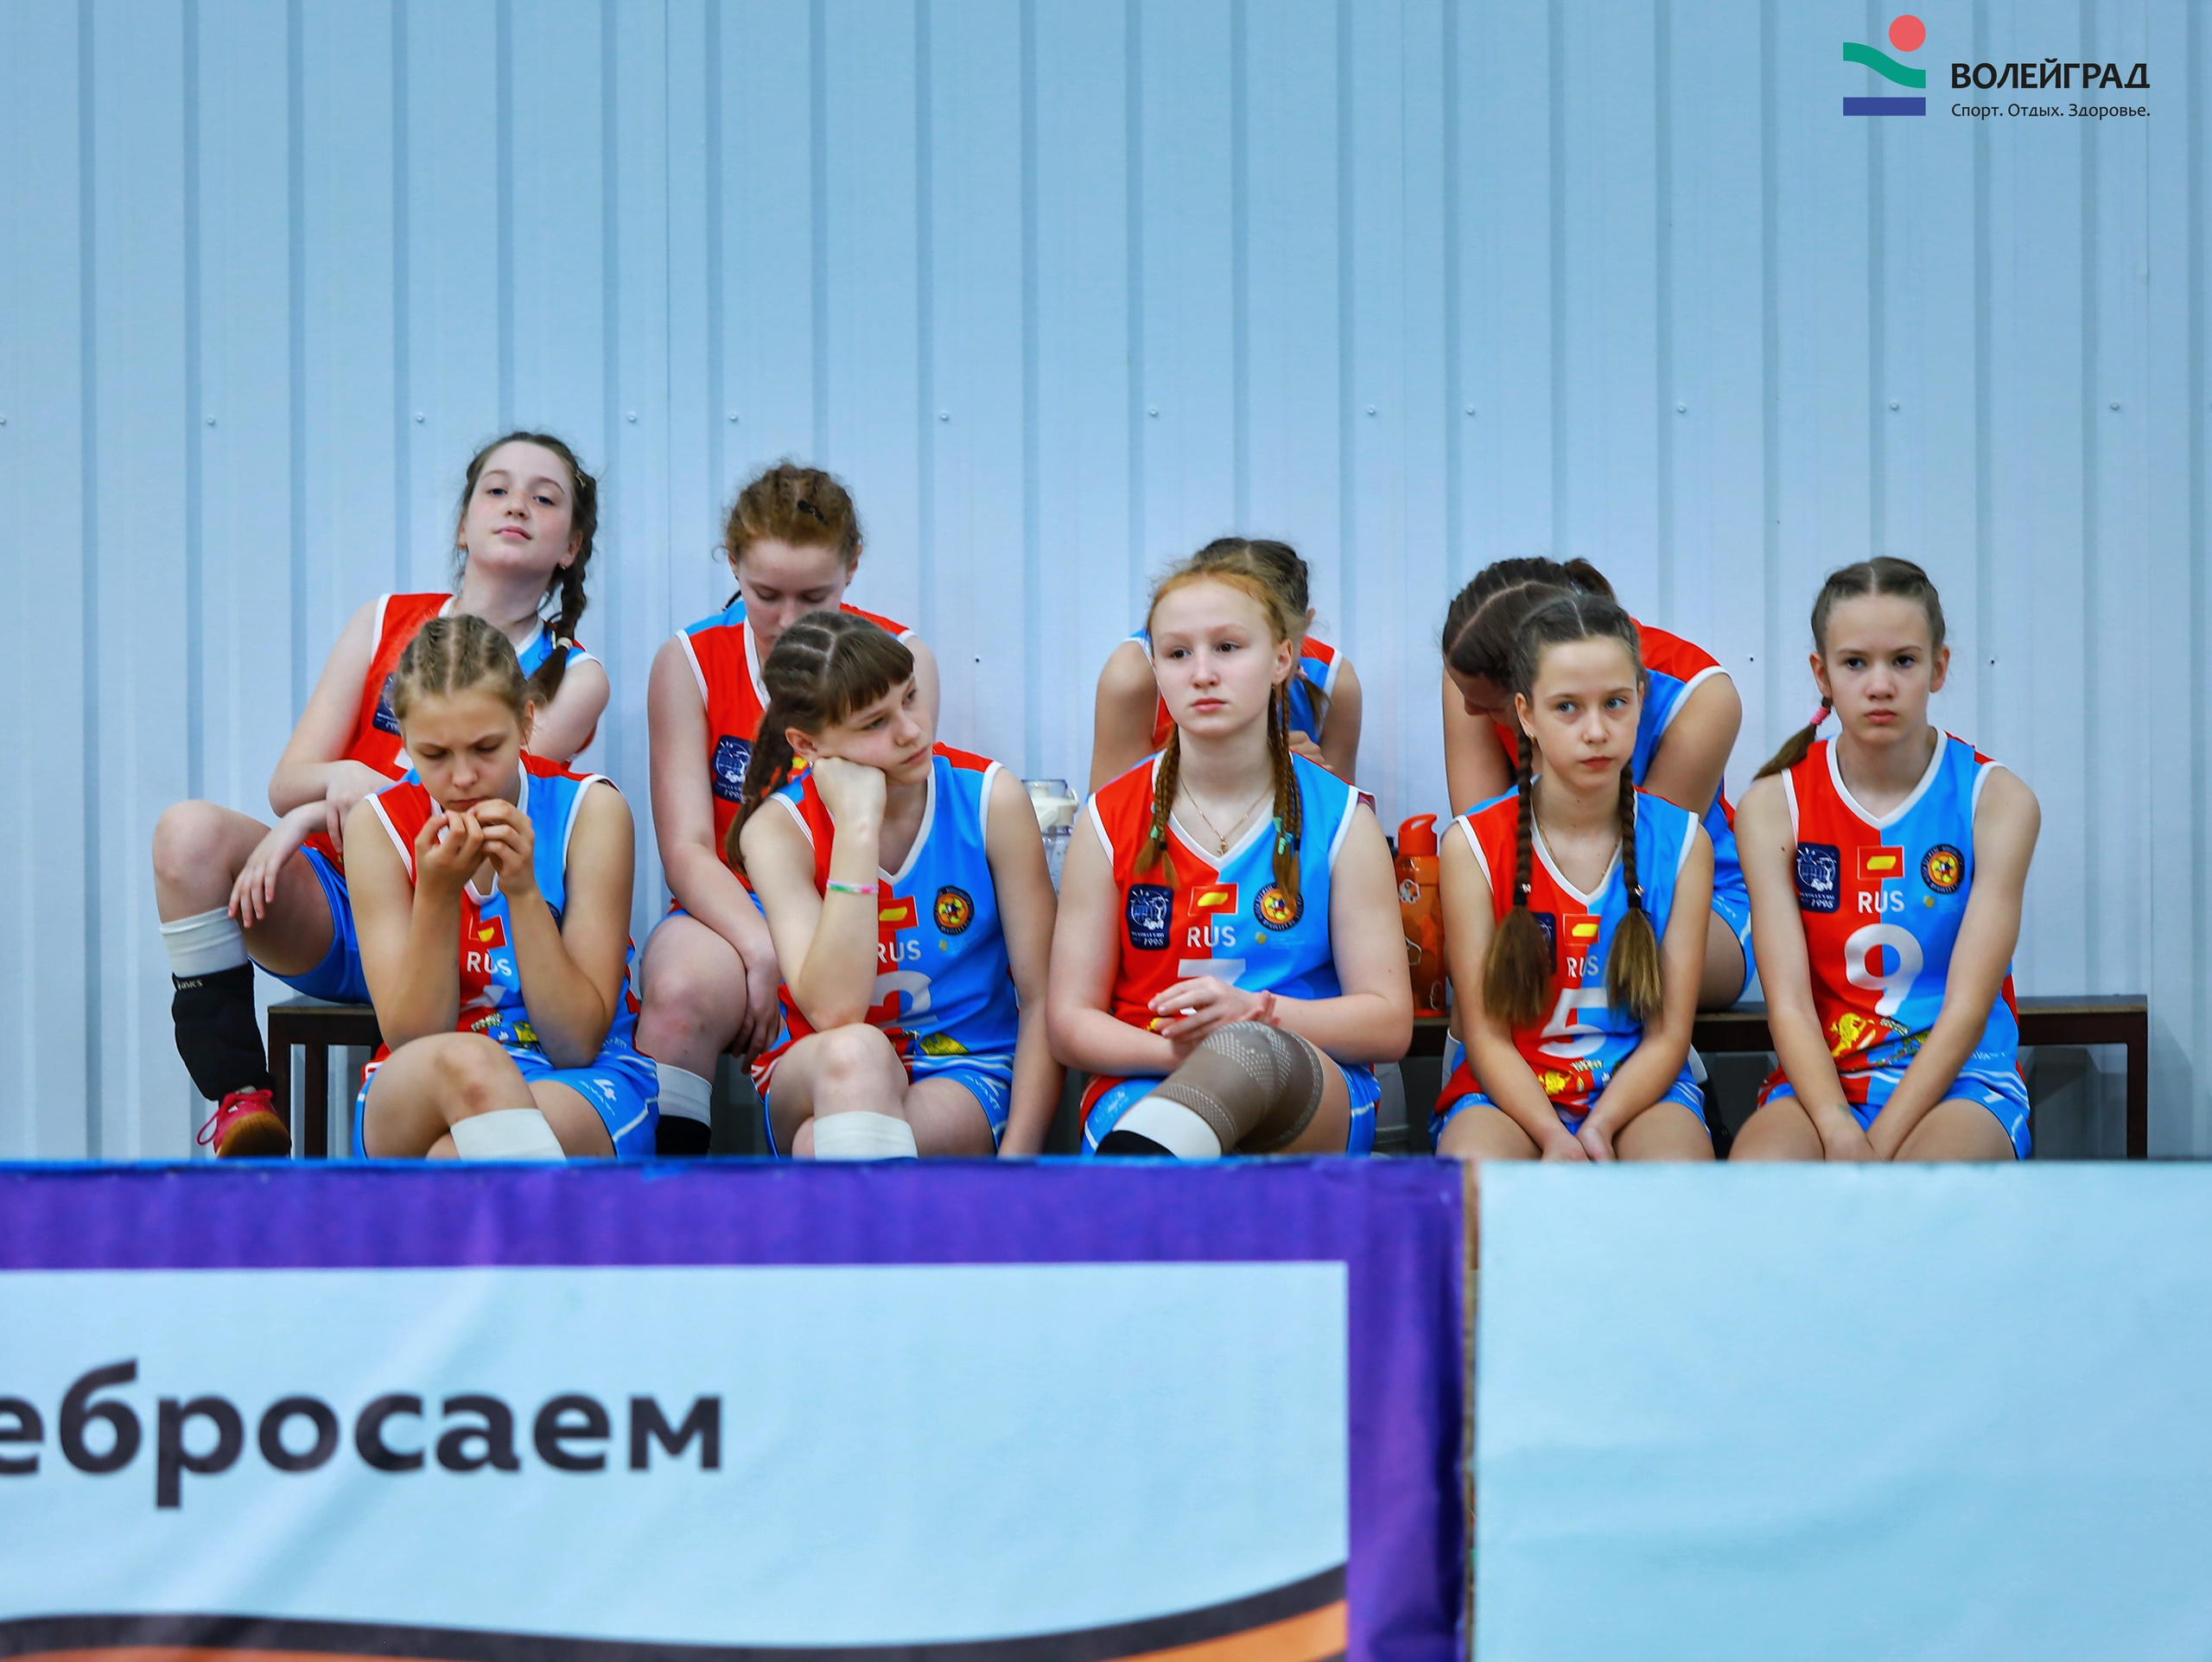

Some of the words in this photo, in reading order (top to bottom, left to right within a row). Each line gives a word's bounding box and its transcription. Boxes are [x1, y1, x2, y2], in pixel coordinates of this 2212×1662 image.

[1858, 890, 1905, 914] RUS
[1186, 925, 1236, 948] RUS
[467, 950, 512, 977] RUS
[1566, 955, 1599, 978] RUS
[1844, 923, 1924, 1018] 9
[1537, 986, 1609, 1059] 5
